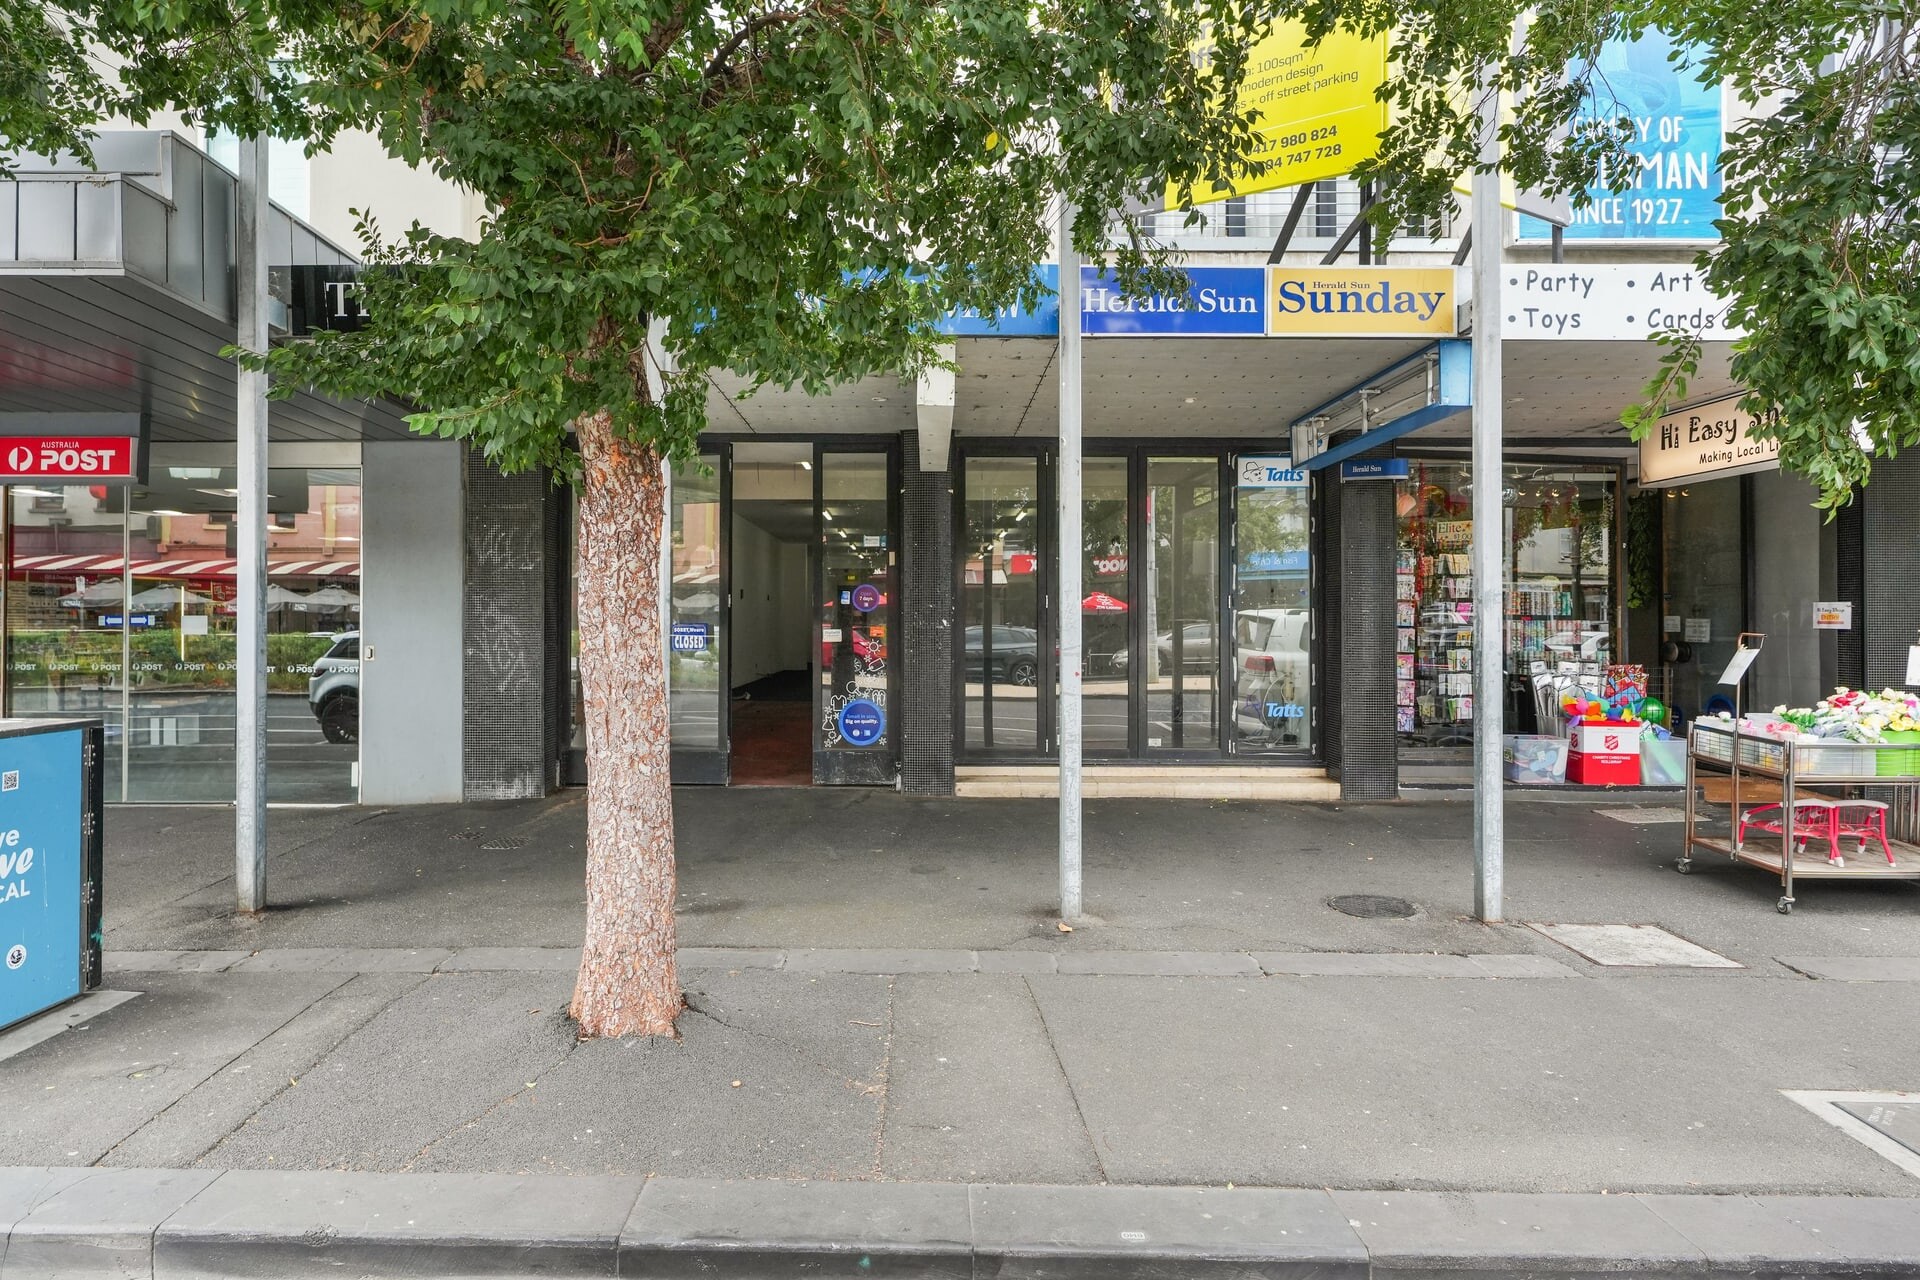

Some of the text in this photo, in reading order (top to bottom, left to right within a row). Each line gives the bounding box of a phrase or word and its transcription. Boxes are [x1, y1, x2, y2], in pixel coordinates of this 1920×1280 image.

[1240, 75, 1283, 92] modern
[1286, 63, 1323, 82] design
[1259, 87, 1275, 104] off
[1277, 82, 1311, 99] street
[1313, 70, 1359, 93] parking
[1252, 125, 1337, 154] 417 980 824
[1659, 116, 1684, 142] OF
[1287, 148, 1311, 166] 747
[1315, 143, 1342, 160] 728
[1631, 198, 1690, 225] 1927.
[1312, 281, 1370, 289] Herald Sun
[1526, 270, 1594, 299] Party
[1650, 271, 1693, 292] Art
[1199, 288, 1258, 313] Sun
[1279, 280, 1446, 321] Sunday
[1523, 308, 1581, 335] Toys
[1647, 308, 1714, 329] Cards
[1661, 423, 1680, 451] Hi
[1689, 416, 1737, 445] Easy
[40, 449, 116, 471] POST
[1699, 440, 1779, 465] Making Local Li
[1265, 467, 1304, 482] Tatts
[1352, 465, 1370, 473] Herald
[675, 636, 704, 648] CLOSED
[58, 663, 79, 671] POST
[100, 663, 122, 671] POST
[141, 663, 163, 671] POST
[184, 663, 206, 671] POST
[296, 665, 317, 673] POST
[338, 665, 360, 673] POST
[1265, 702, 1304, 718] Tatts
